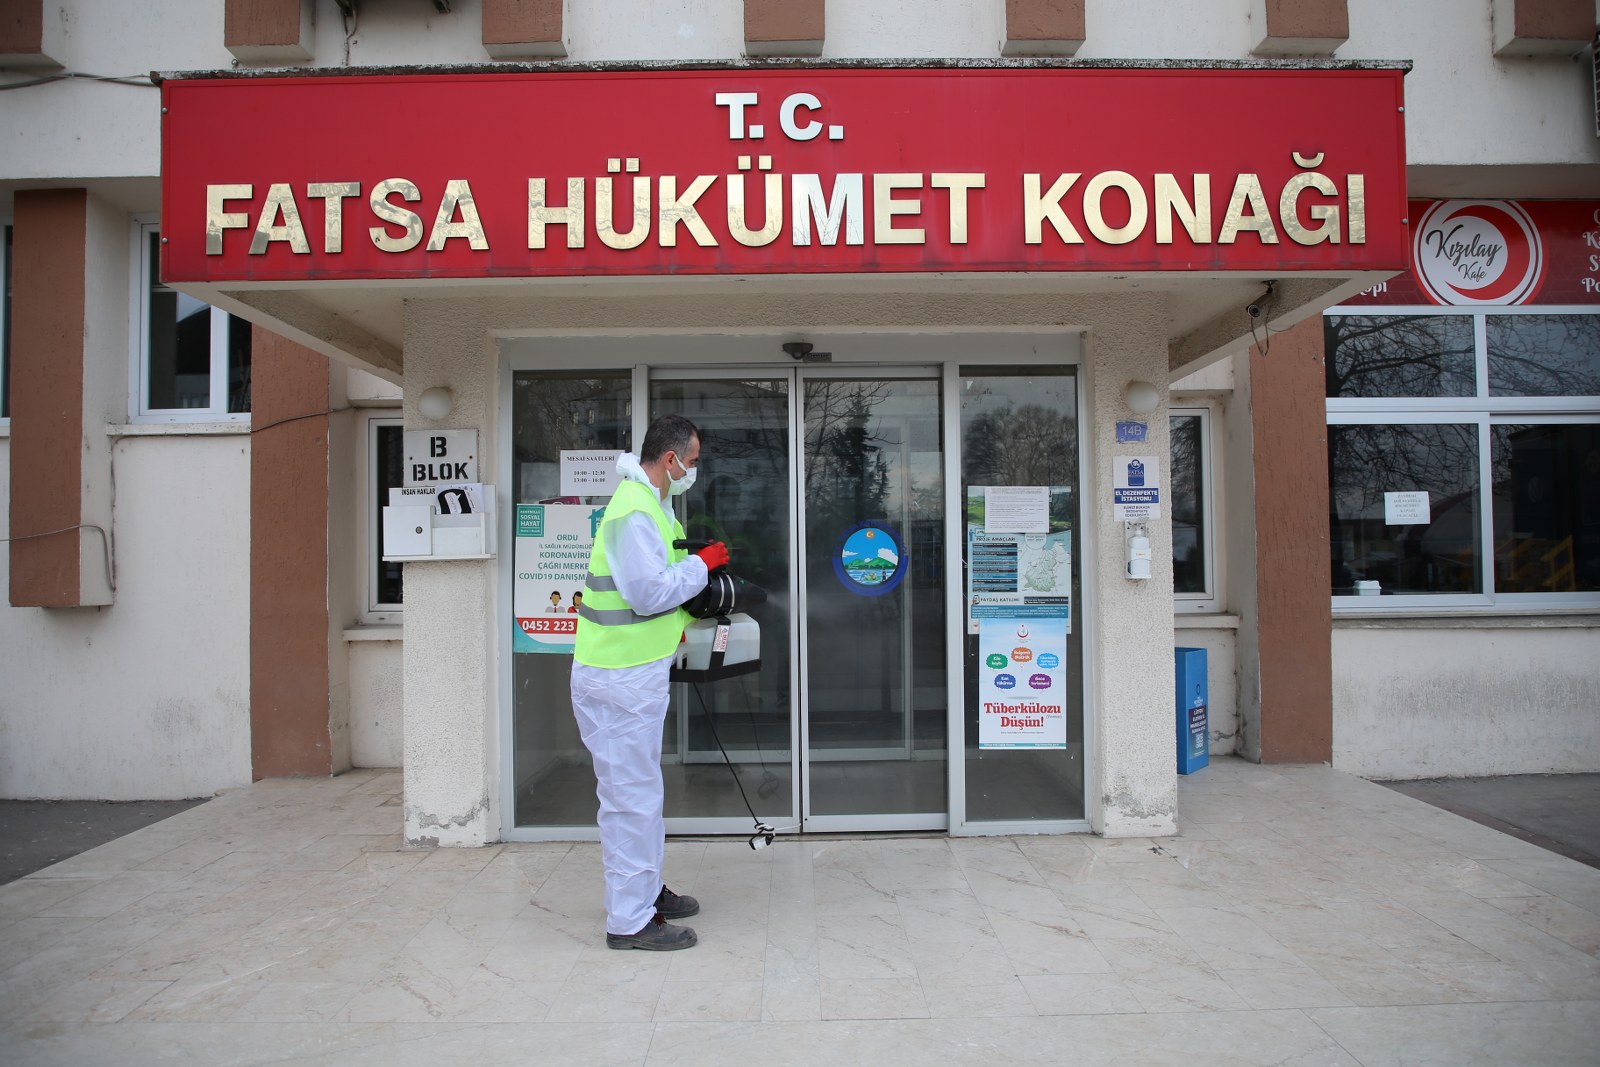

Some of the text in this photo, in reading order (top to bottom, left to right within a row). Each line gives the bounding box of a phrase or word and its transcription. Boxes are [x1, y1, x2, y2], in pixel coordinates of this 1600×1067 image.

[205, 152, 1366, 255] FATSA HÜKÜMET KONAĞI
[1425, 224, 1503, 267] Kızılay
[1458, 261, 1488, 283] Kafe
[1122, 425, 1142, 436] 14B
[430, 436, 447, 458] B
[412, 462, 469, 482] BLOK
[417, 487, 436, 495] HAKLAR
[539, 551, 591, 559] KORONAVİRÜ
[537, 562, 589, 571] ÇAĞRI MERKE
[519, 572, 586, 582] COVID19 DANIŞM
[522, 620, 575, 632] 0452 223
[983, 702, 1062, 714] Tüberkülozu
[1000, 715, 1044, 730] Düşün!
